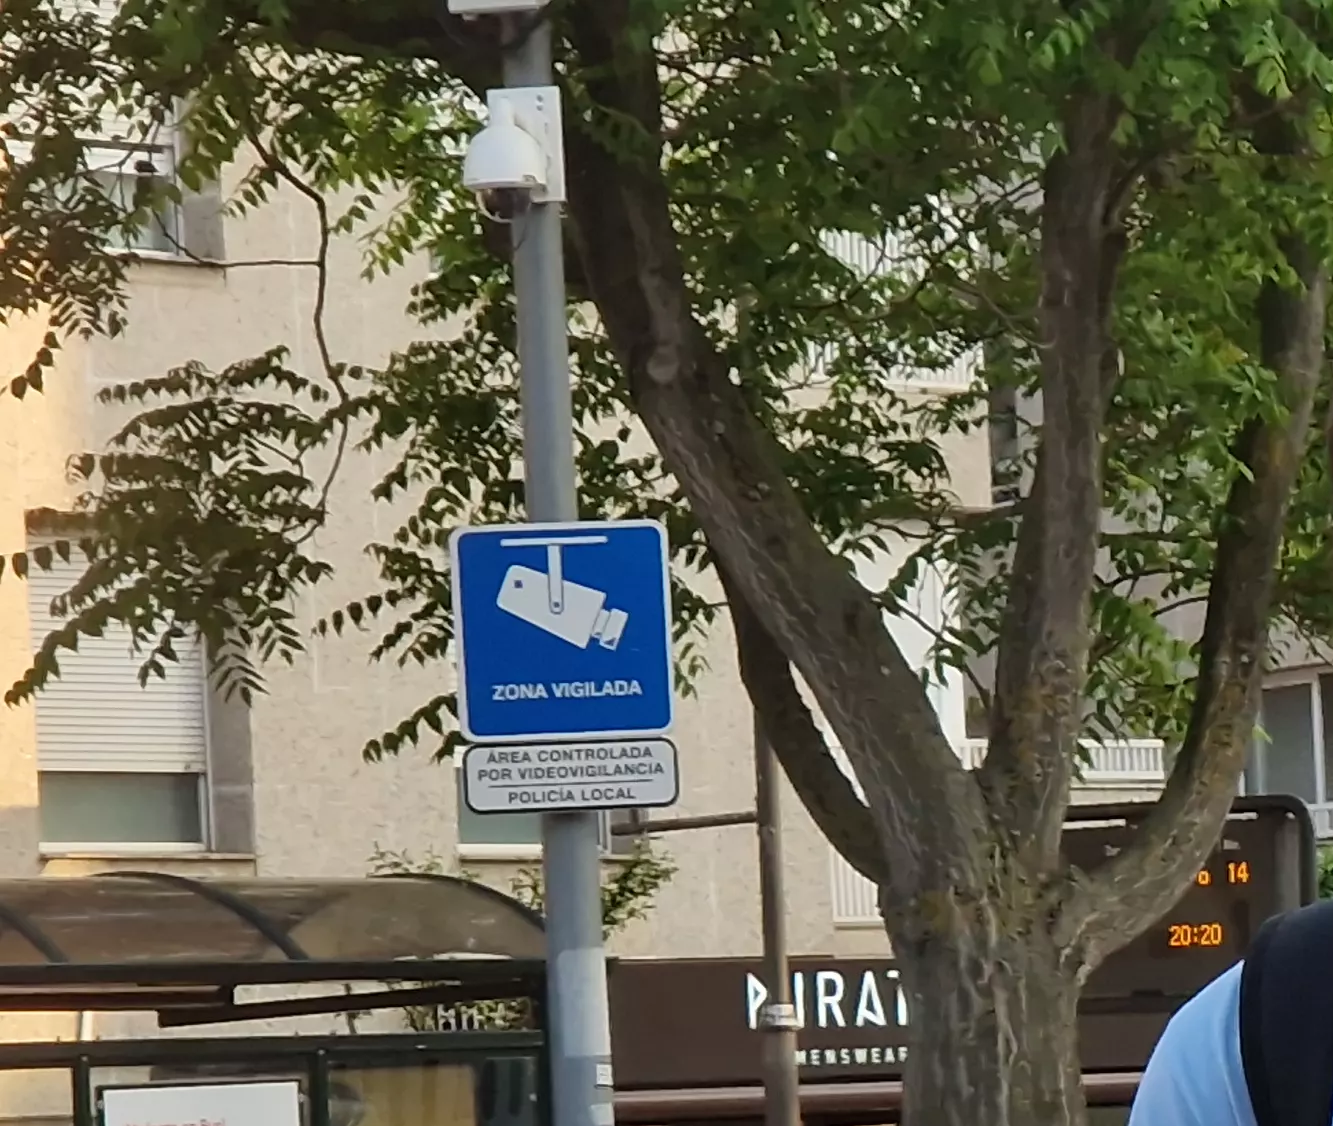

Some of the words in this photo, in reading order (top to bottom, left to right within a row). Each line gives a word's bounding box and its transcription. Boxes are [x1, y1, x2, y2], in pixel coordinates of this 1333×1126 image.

[492, 683, 549, 701] ZONA
[551, 679, 643, 699] VIGILADA
[486, 748, 532, 765] ÁREA
[537, 745, 654, 763] CONTROLADA
[477, 767, 514, 782] POR
[518, 762, 665, 781] VIDEOVIGILANCIA
[507, 787, 576, 804] POLICÍA
[580, 786, 637, 802] LOCAL
[1227, 861, 1249, 883] 14
[1168, 922, 1223, 947] 20:20
